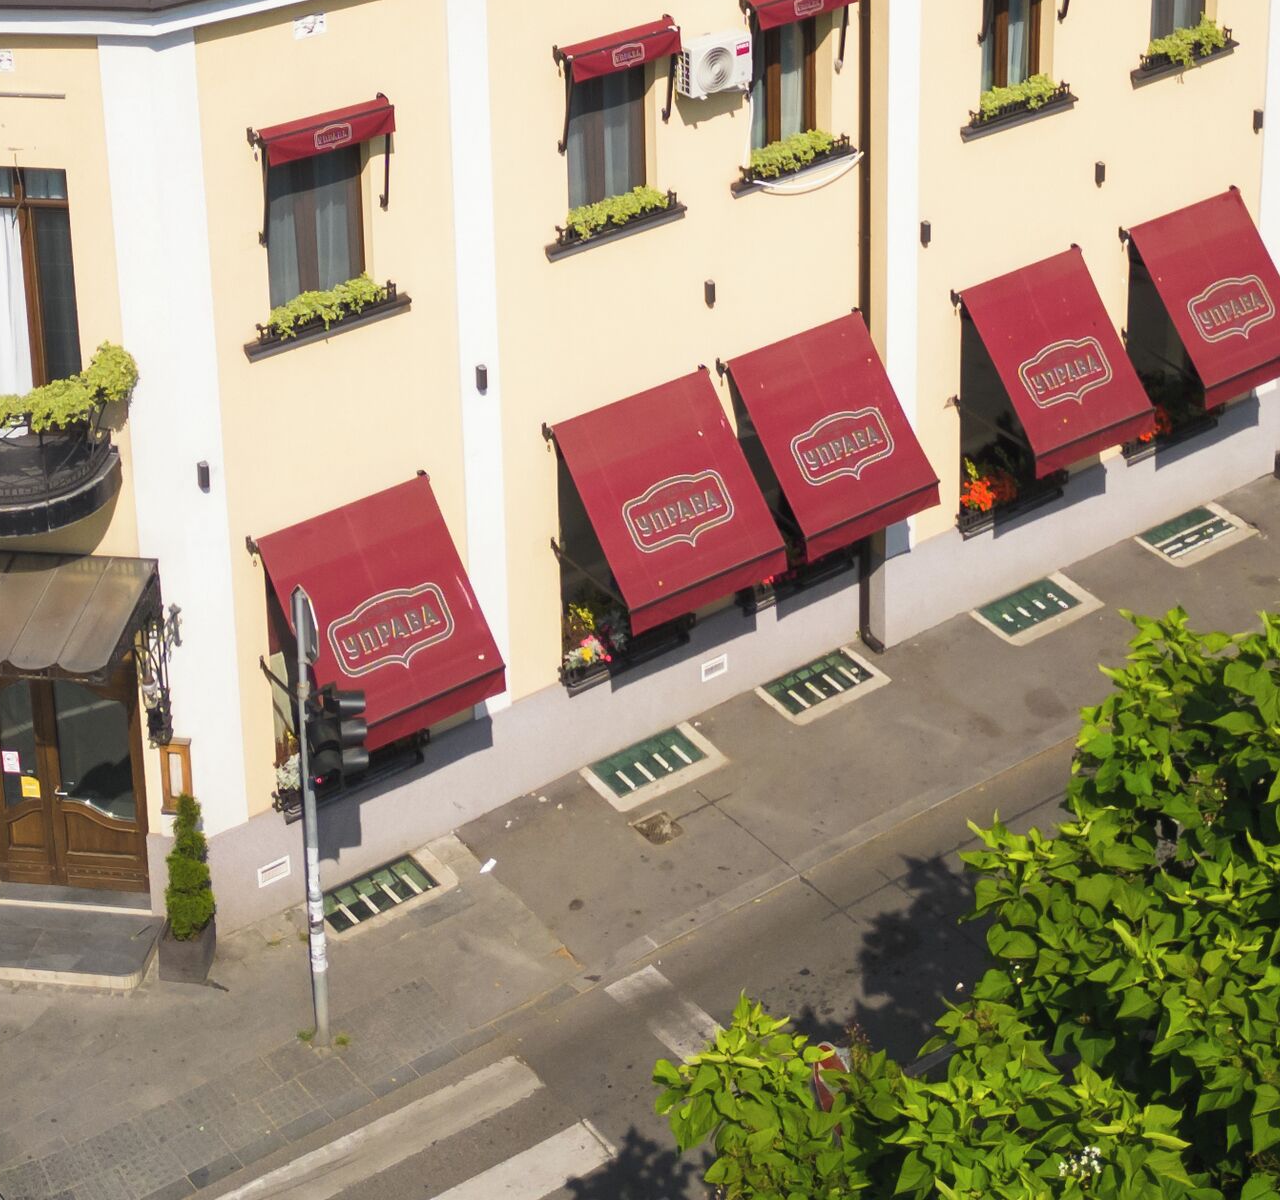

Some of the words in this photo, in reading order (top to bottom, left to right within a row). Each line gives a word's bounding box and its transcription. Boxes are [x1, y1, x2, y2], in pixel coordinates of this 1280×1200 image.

[1198, 290, 1266, 330] УПРАВА
[1031, 352, 1103, 395] УПРАВА
[802, 425, 884, 471] УПРАВА
[635, 488, 723, 537] УПРАВА
[341, 602, 442, 660] УПРАВА
